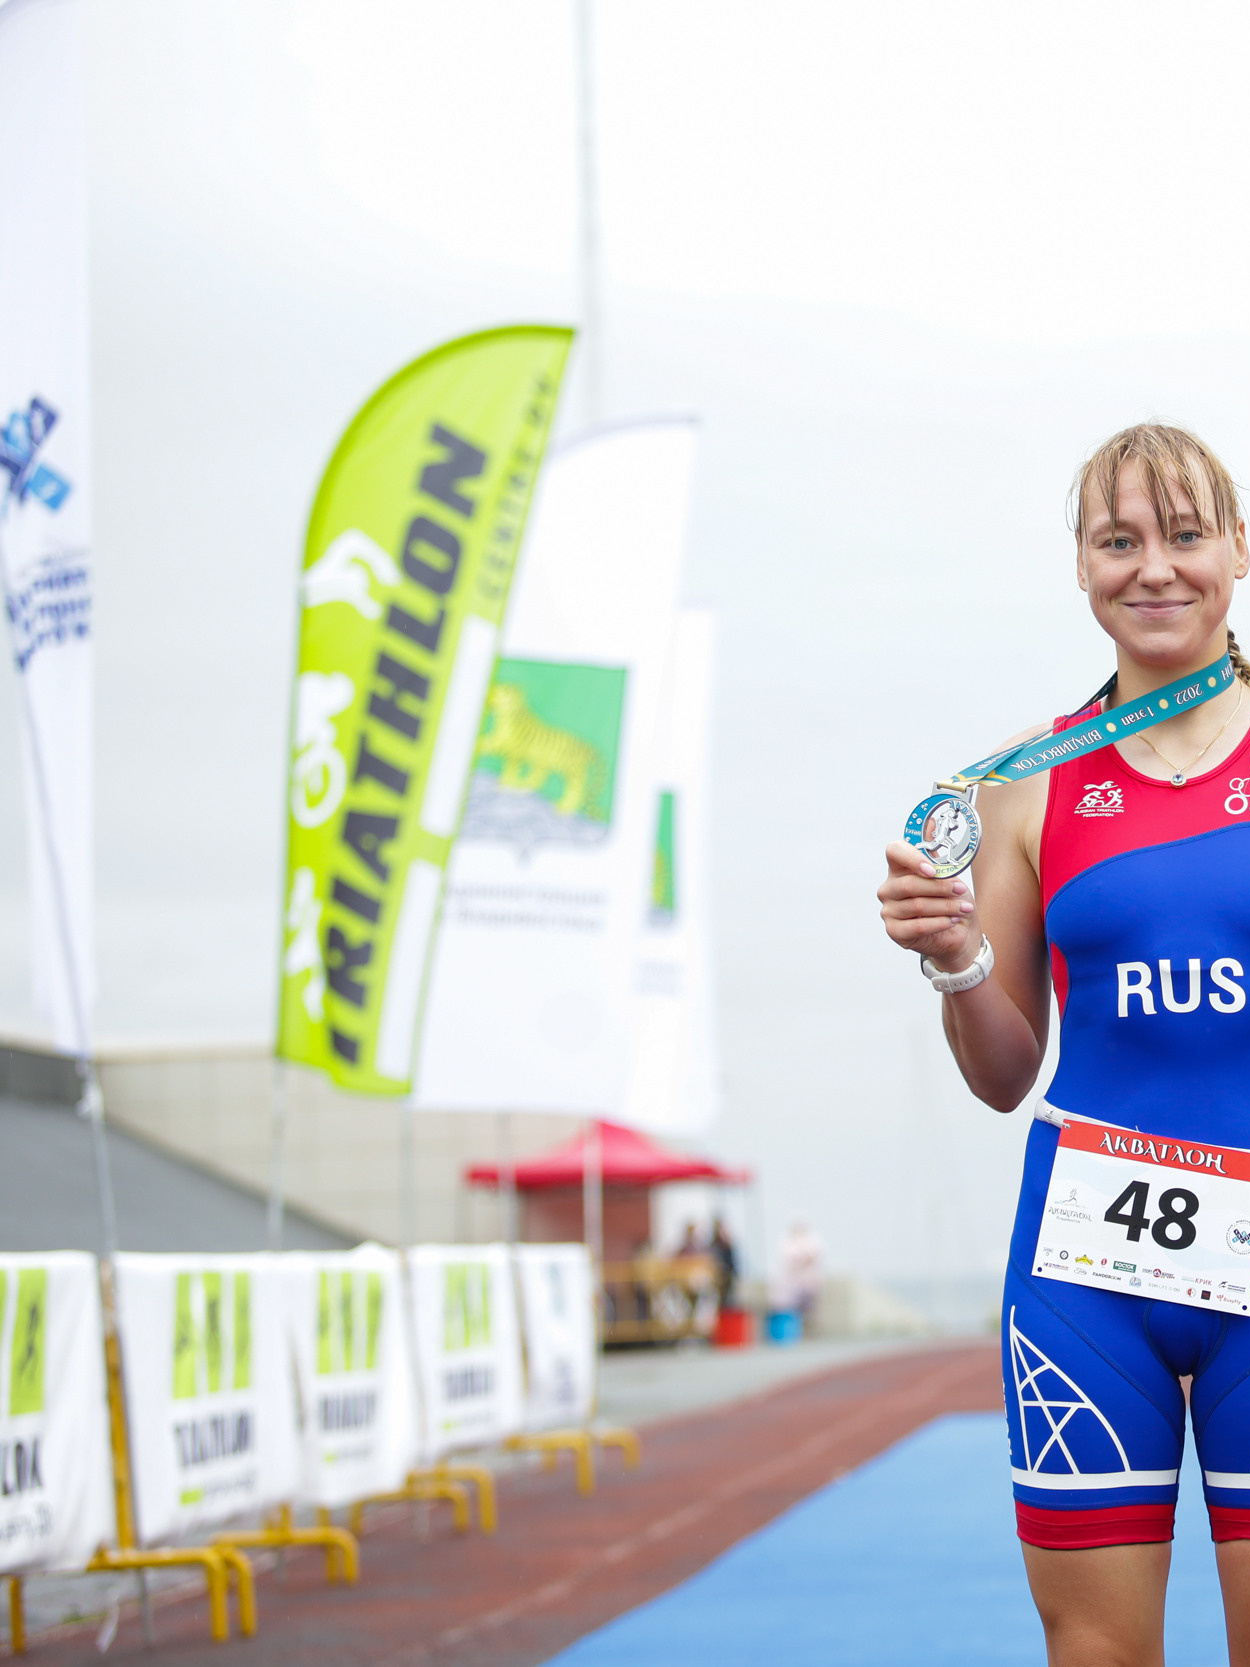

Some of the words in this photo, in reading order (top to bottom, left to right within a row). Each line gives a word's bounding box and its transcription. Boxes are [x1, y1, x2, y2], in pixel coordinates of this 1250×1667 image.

[1173, 683, 1204, 705] 2022
[1120, 708, 1147, 726] этап
[1009, 729, 1104, 772] ВЛАДИВОСТОК
[1117, 957, 1246, 1018] RUS
[1099, 1132, 1228, 1175] АКВАТЛОН
[1104, 1181, 1200, 1250] 48
[1194, 1277, 1213, 1287] КРИК
